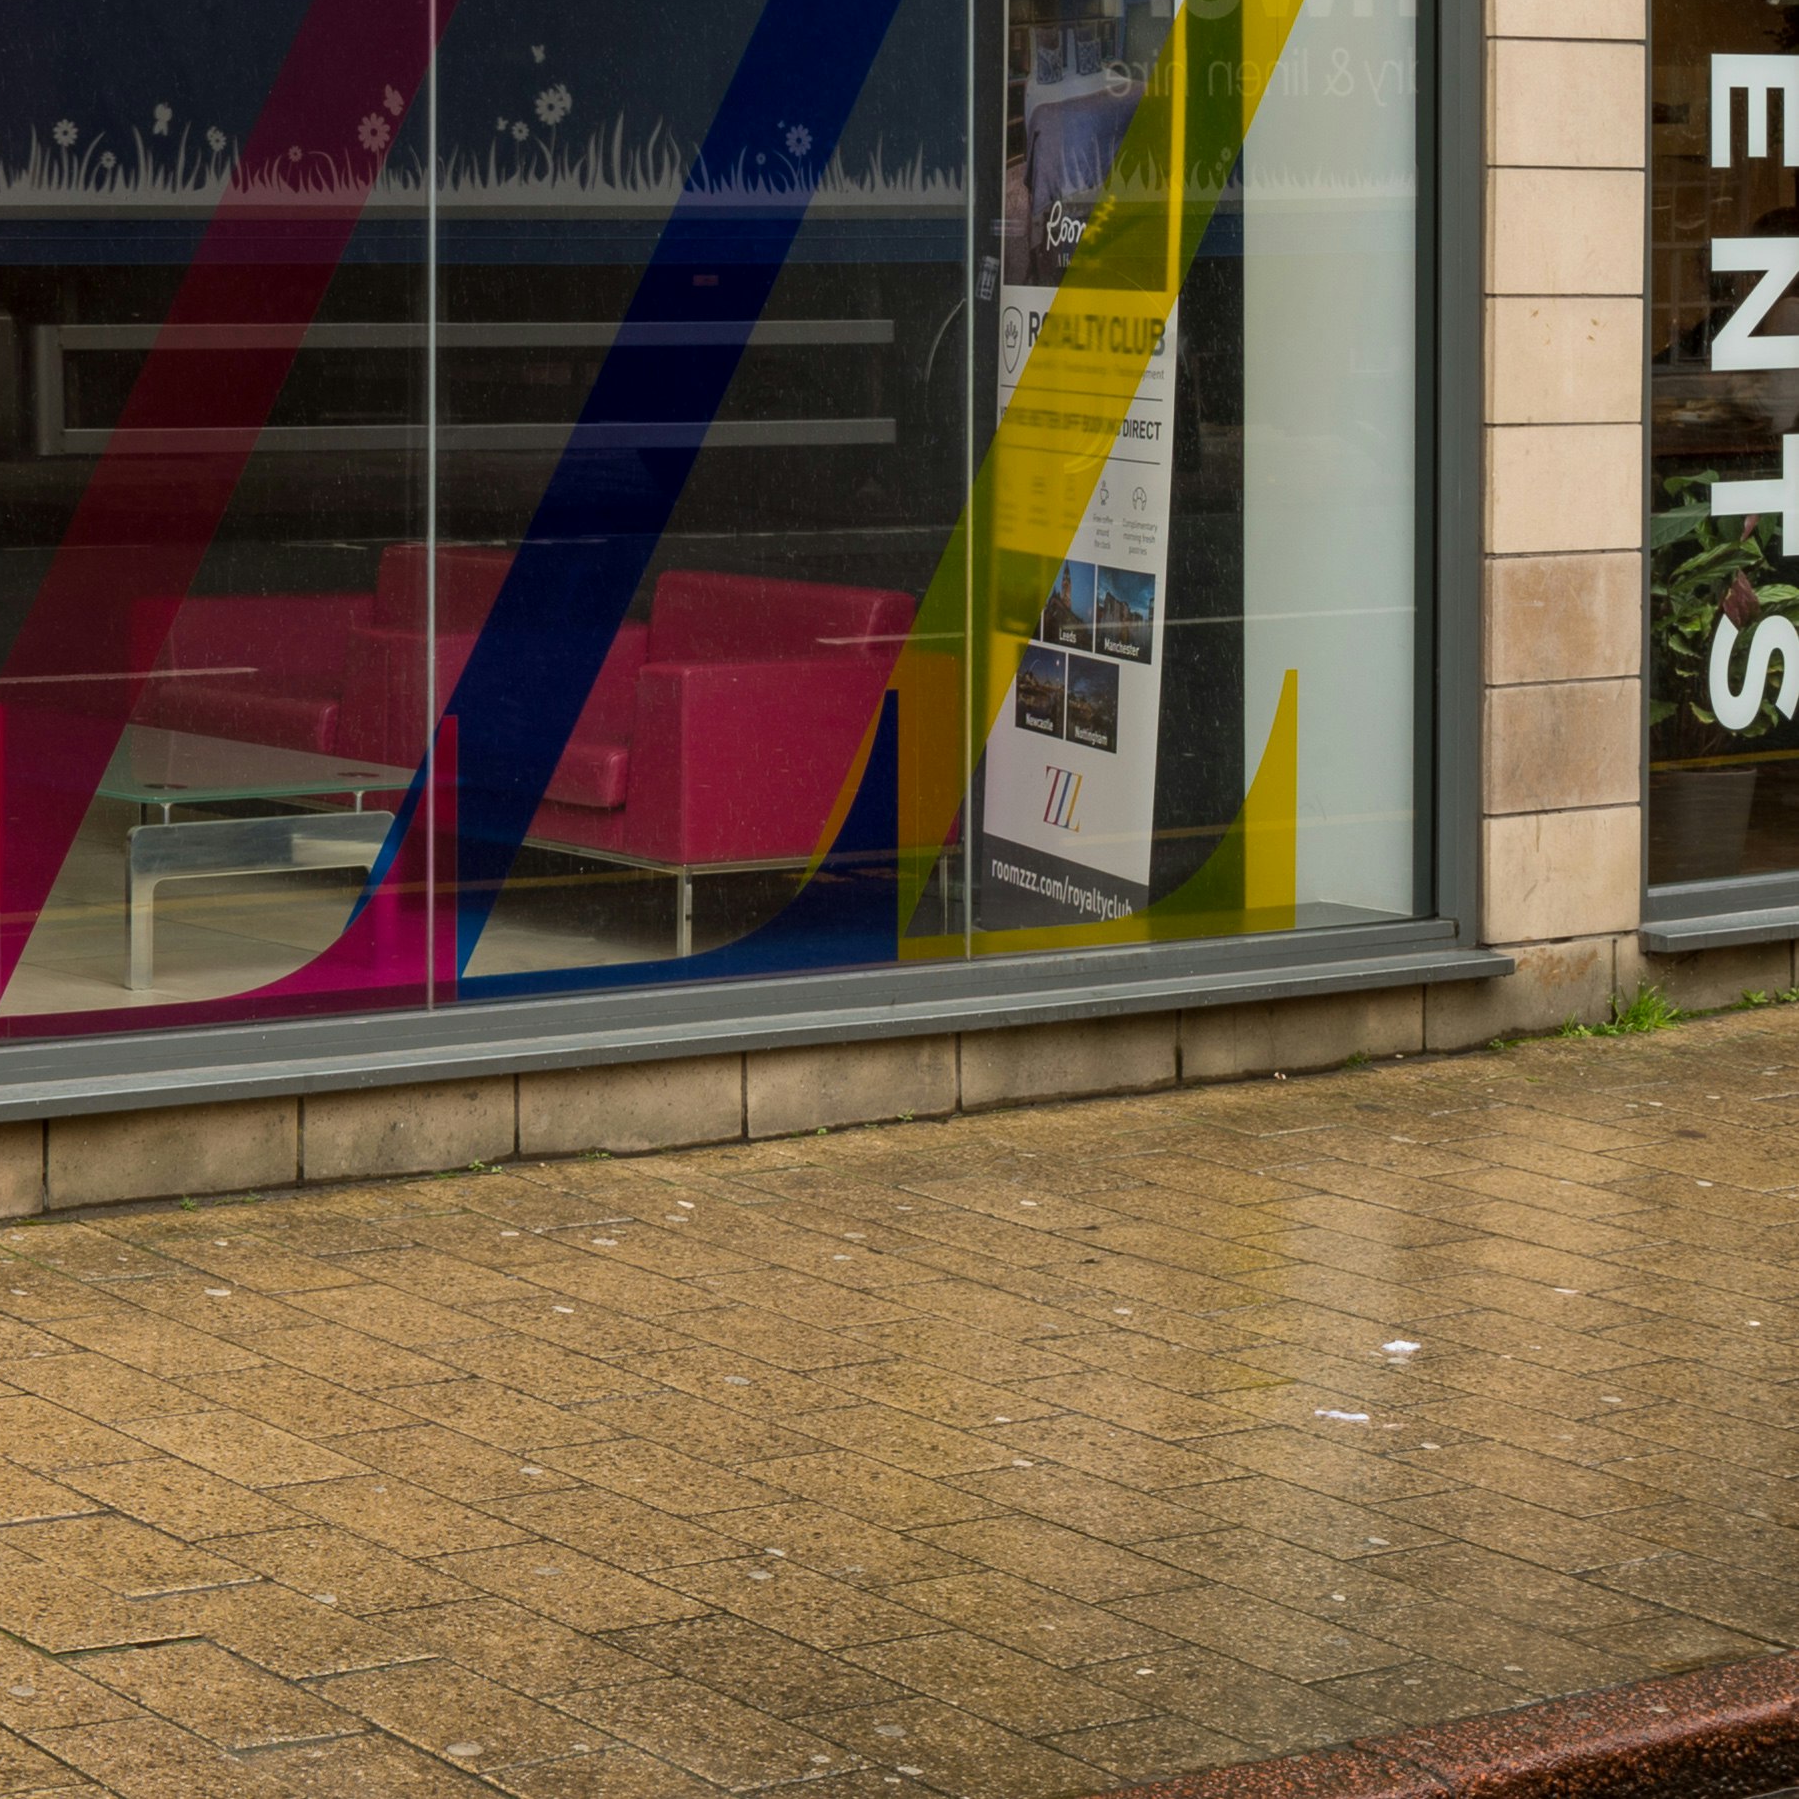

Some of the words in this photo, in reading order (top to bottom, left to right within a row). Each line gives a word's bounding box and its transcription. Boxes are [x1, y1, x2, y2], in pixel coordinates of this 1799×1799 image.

[1109, 316, 1166, 357] CLUB
[1123, 419, 1162, 441] DIRECT
[1059, 627, 1077, 643] Leeds
[1104, 638, 1140, 657] Manchester
[1025, 712, 1053, 731] Newcastle
[1074, 726, 1108, 746] Nottingham
[991, 859, 1133, 922] roomzzz.com/royaltyclub
